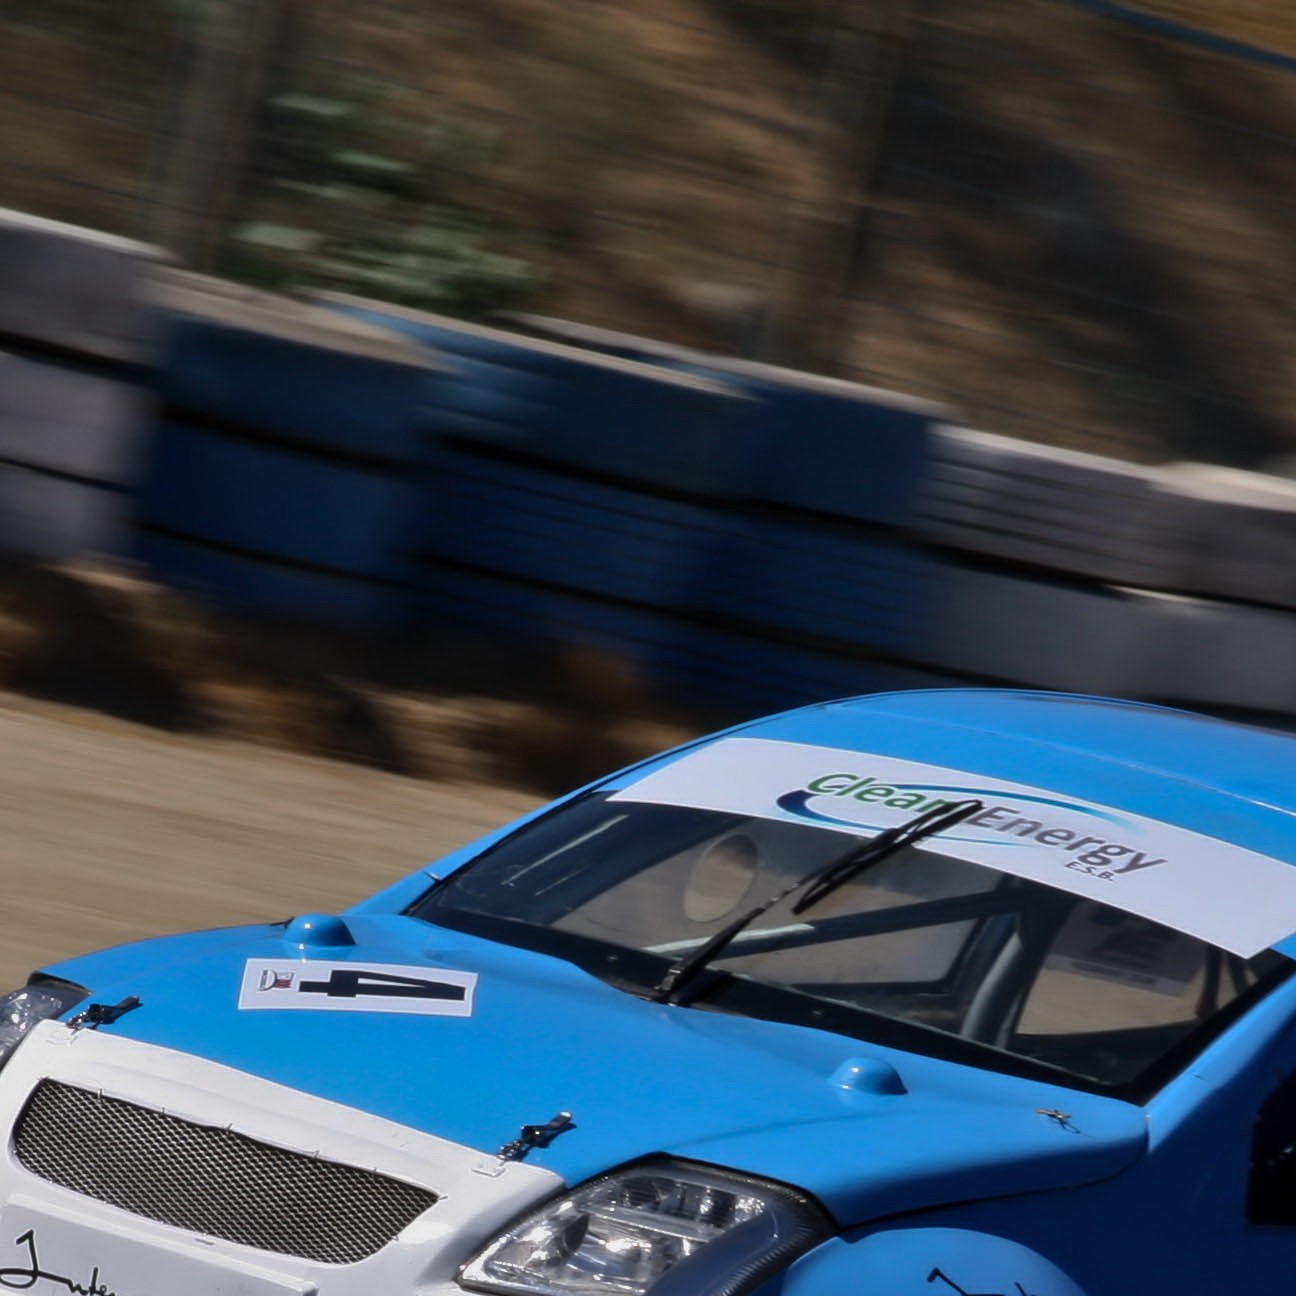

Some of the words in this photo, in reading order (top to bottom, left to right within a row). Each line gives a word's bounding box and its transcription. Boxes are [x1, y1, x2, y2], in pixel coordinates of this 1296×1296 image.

[965, 804, 1168, 875] Energy
[1064, 861, 1116, 882] E.S.B.
[299, 969, 467, 1001] 4
